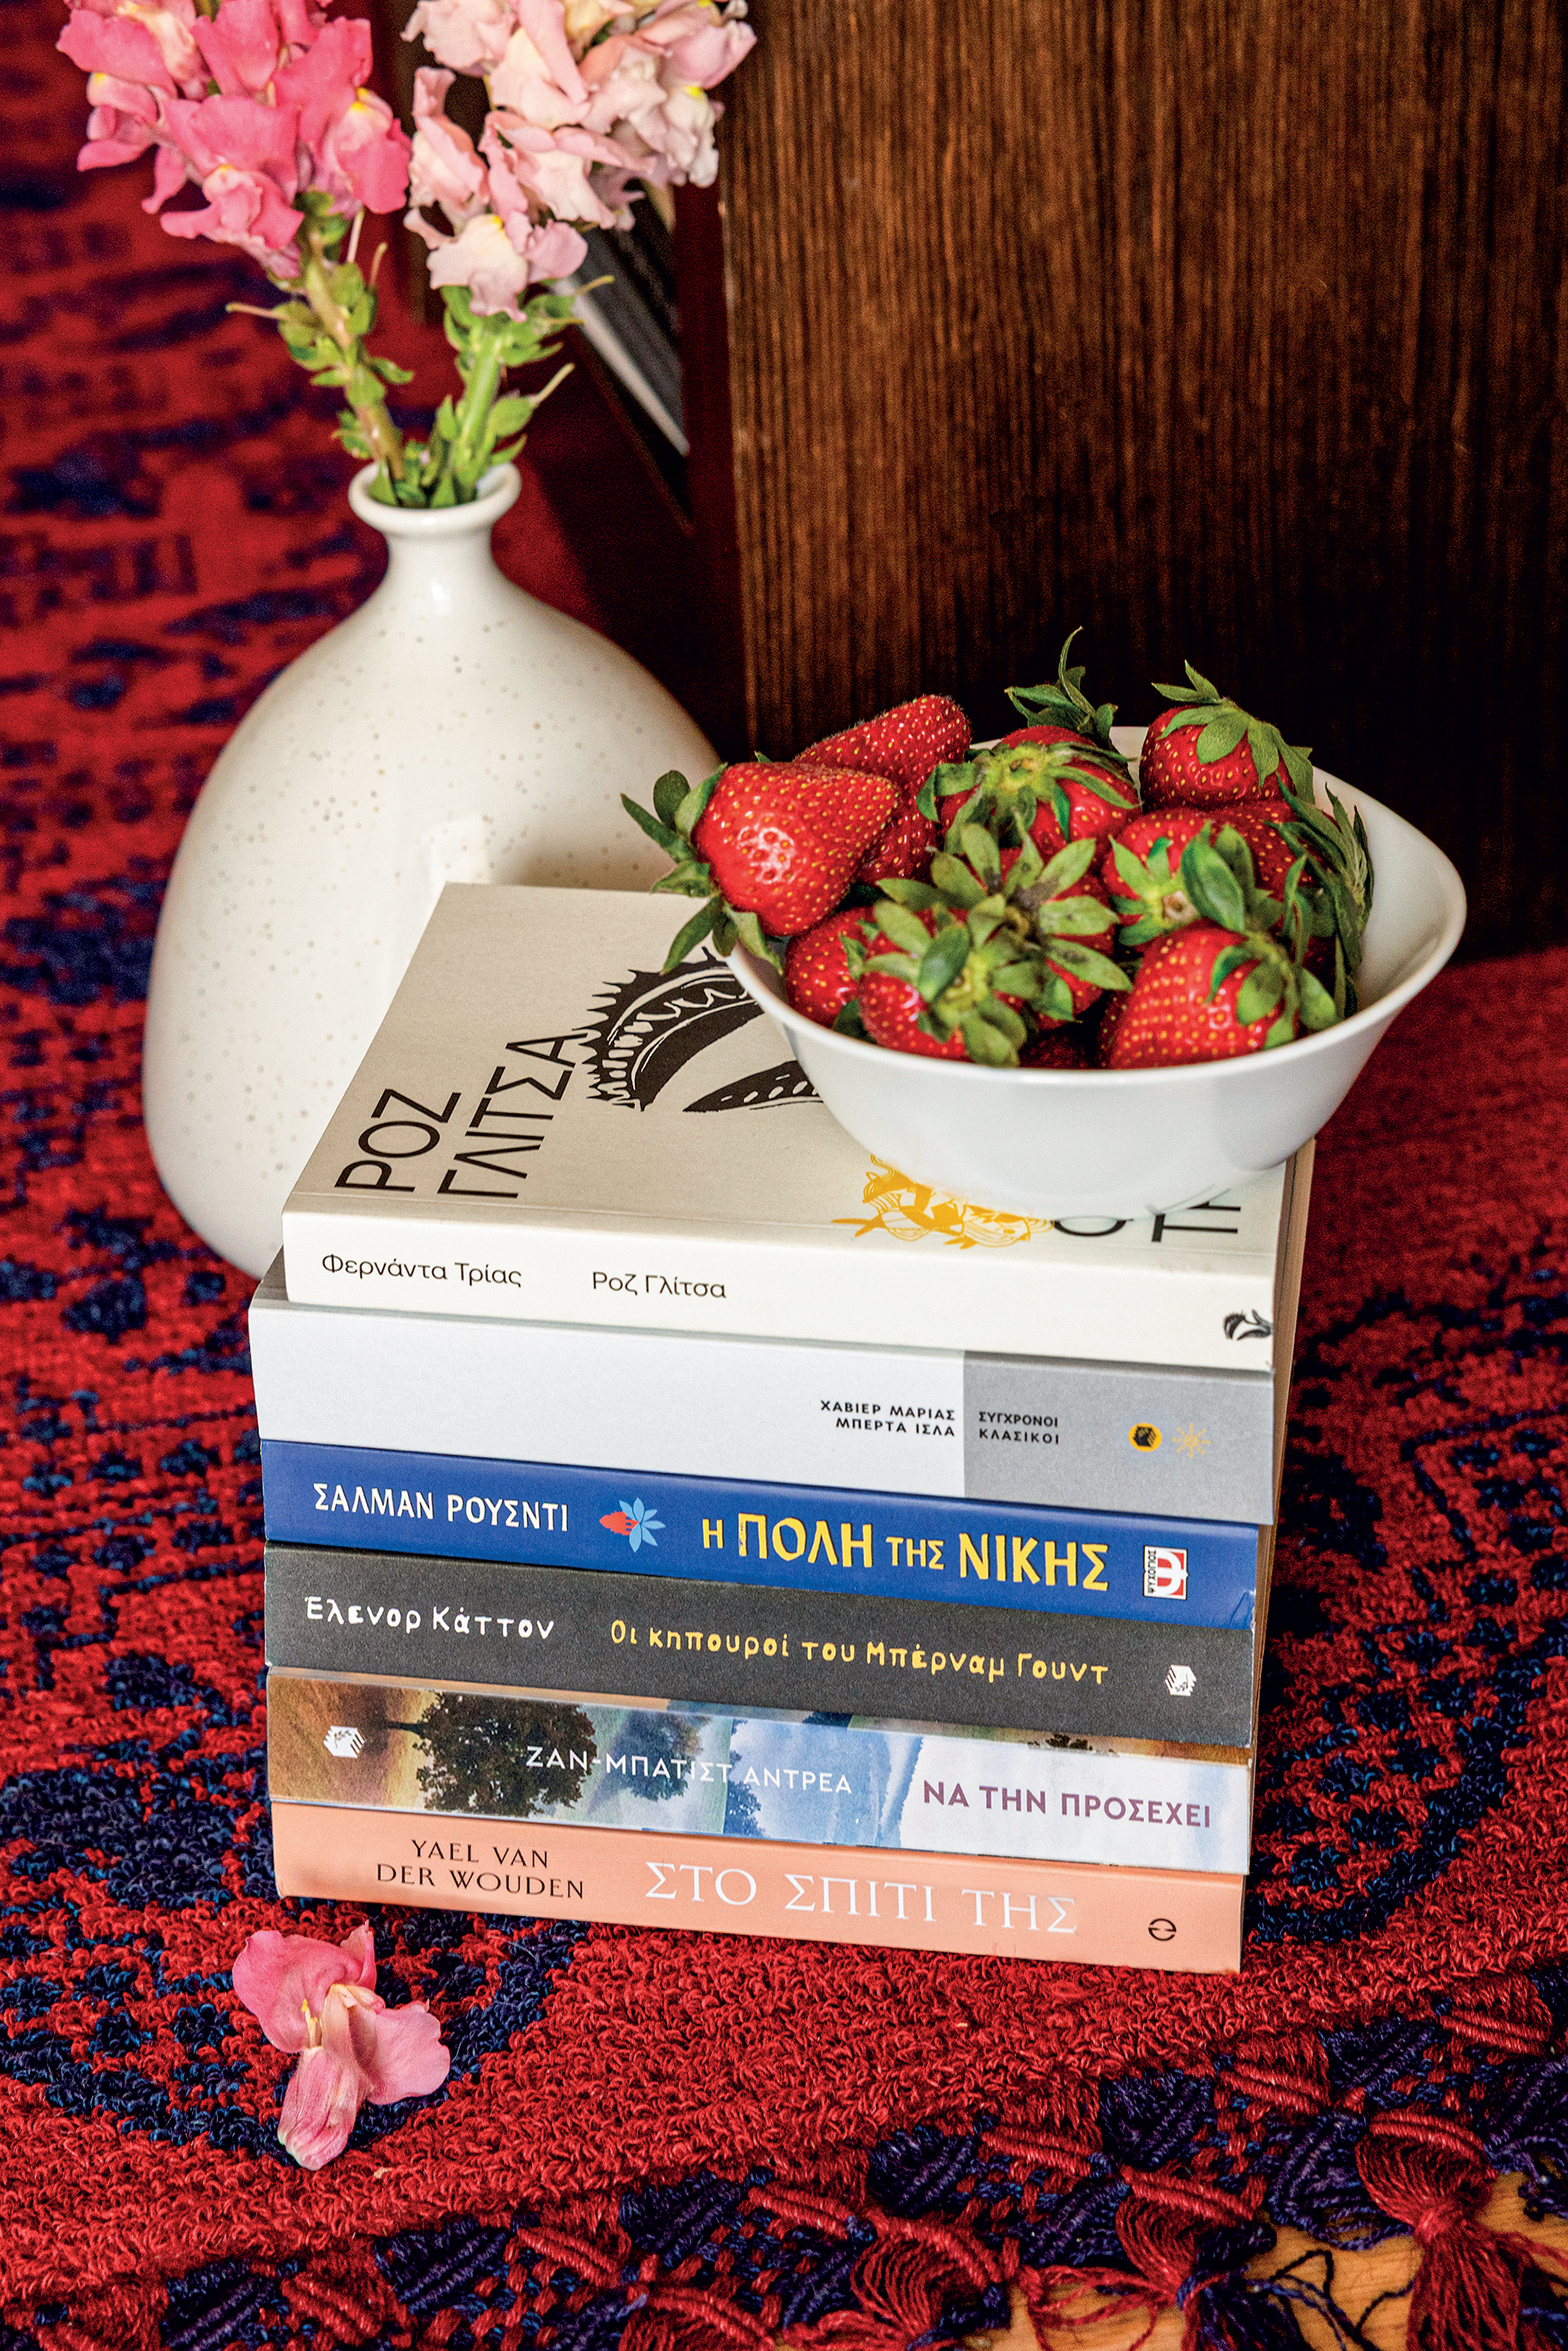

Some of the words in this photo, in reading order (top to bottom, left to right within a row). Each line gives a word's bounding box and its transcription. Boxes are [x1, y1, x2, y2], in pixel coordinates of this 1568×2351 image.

[436, 1032, 589, 1199] ΓΛΙΤΣΑ
[334, 1088, 462, 1193] ΡΟΖ
[322, 1253, 448, 1280] Φερνάντα
[454, 1262, 522, 1288] Τρίας
[592, 1271, 638, 1296] Ροζ
[645, 1274, 727, 1299] Γλίτσα
[820, 1399, 881, 1415] ΧΑΒΙΕΡ
[889, 1405, 956, 1421] ΜΑΡΙΑΣ
[835, 1417, 906, 1434] ΜΠΕΡΤΑ
[915, 1423, 956, 1437] ΙΣΛΑ
[978, 1411, 1058, 1428] ΣΥΓΧΡΟΝΟΙ
[979, 1428, 1059, 1445] ΚΛΑΣΙΚΟΙ
[313, 1483, 434, 1519] ΣΑΛΜΑΝ
[447, 1494, 568, 1532] ΡΟΥΣΝΤΙ
[702, 1519, 724, 1549] Η
[738, 1512, 873, 1568] ΠΟΛΗ
[885, 1536, 944, 1571] ΤΗΣ
[959, 1532, 1108, 1592] ΝΙΚΗΣ
[1147, 1550, 1156, 1594] ΨΥΧΟΓΙΟΣ
[305, 1595, 421, 1634] Έλενορ
[433, 1606, 555, 1639] Κάττον
[611, 1619, 638, 1644] Οι
[649, 1626, 789, 1660] κηπουροί
[801, 1641, 855, 1662] του
[866, 1640, 1004, 1684] Μπέρναμ
[1018, 1653, 1109, 1685] Γουντ
[526, 1746, 733, 1784] ΖΑΝ-ΜΠΑΤΙΣΤ
[742, 1767, 853, 1795] ΑΝΤΡΕΑ
[924, 1779, 970, 1808] ΝΑ
[978, 1785, 1046, 1814] ΤΗΝ
[1061, 1792, 1210, 1828] ΠΡΟΣΕΧΕΙ
[411, 1839, 479, 1864] YAEL
[492, 1846, 548, 1869] VAN
[376, 1863, 435, 1887] DER
[449, 1870, 584, 1900] WOUDEN
[645, 1861, 758, 1906] ΣΤΟ
[784, 1873, 935, 1922] ΣΠΙΤΙ
[961, 1889, 1078, 1934] ΤΗΣ
